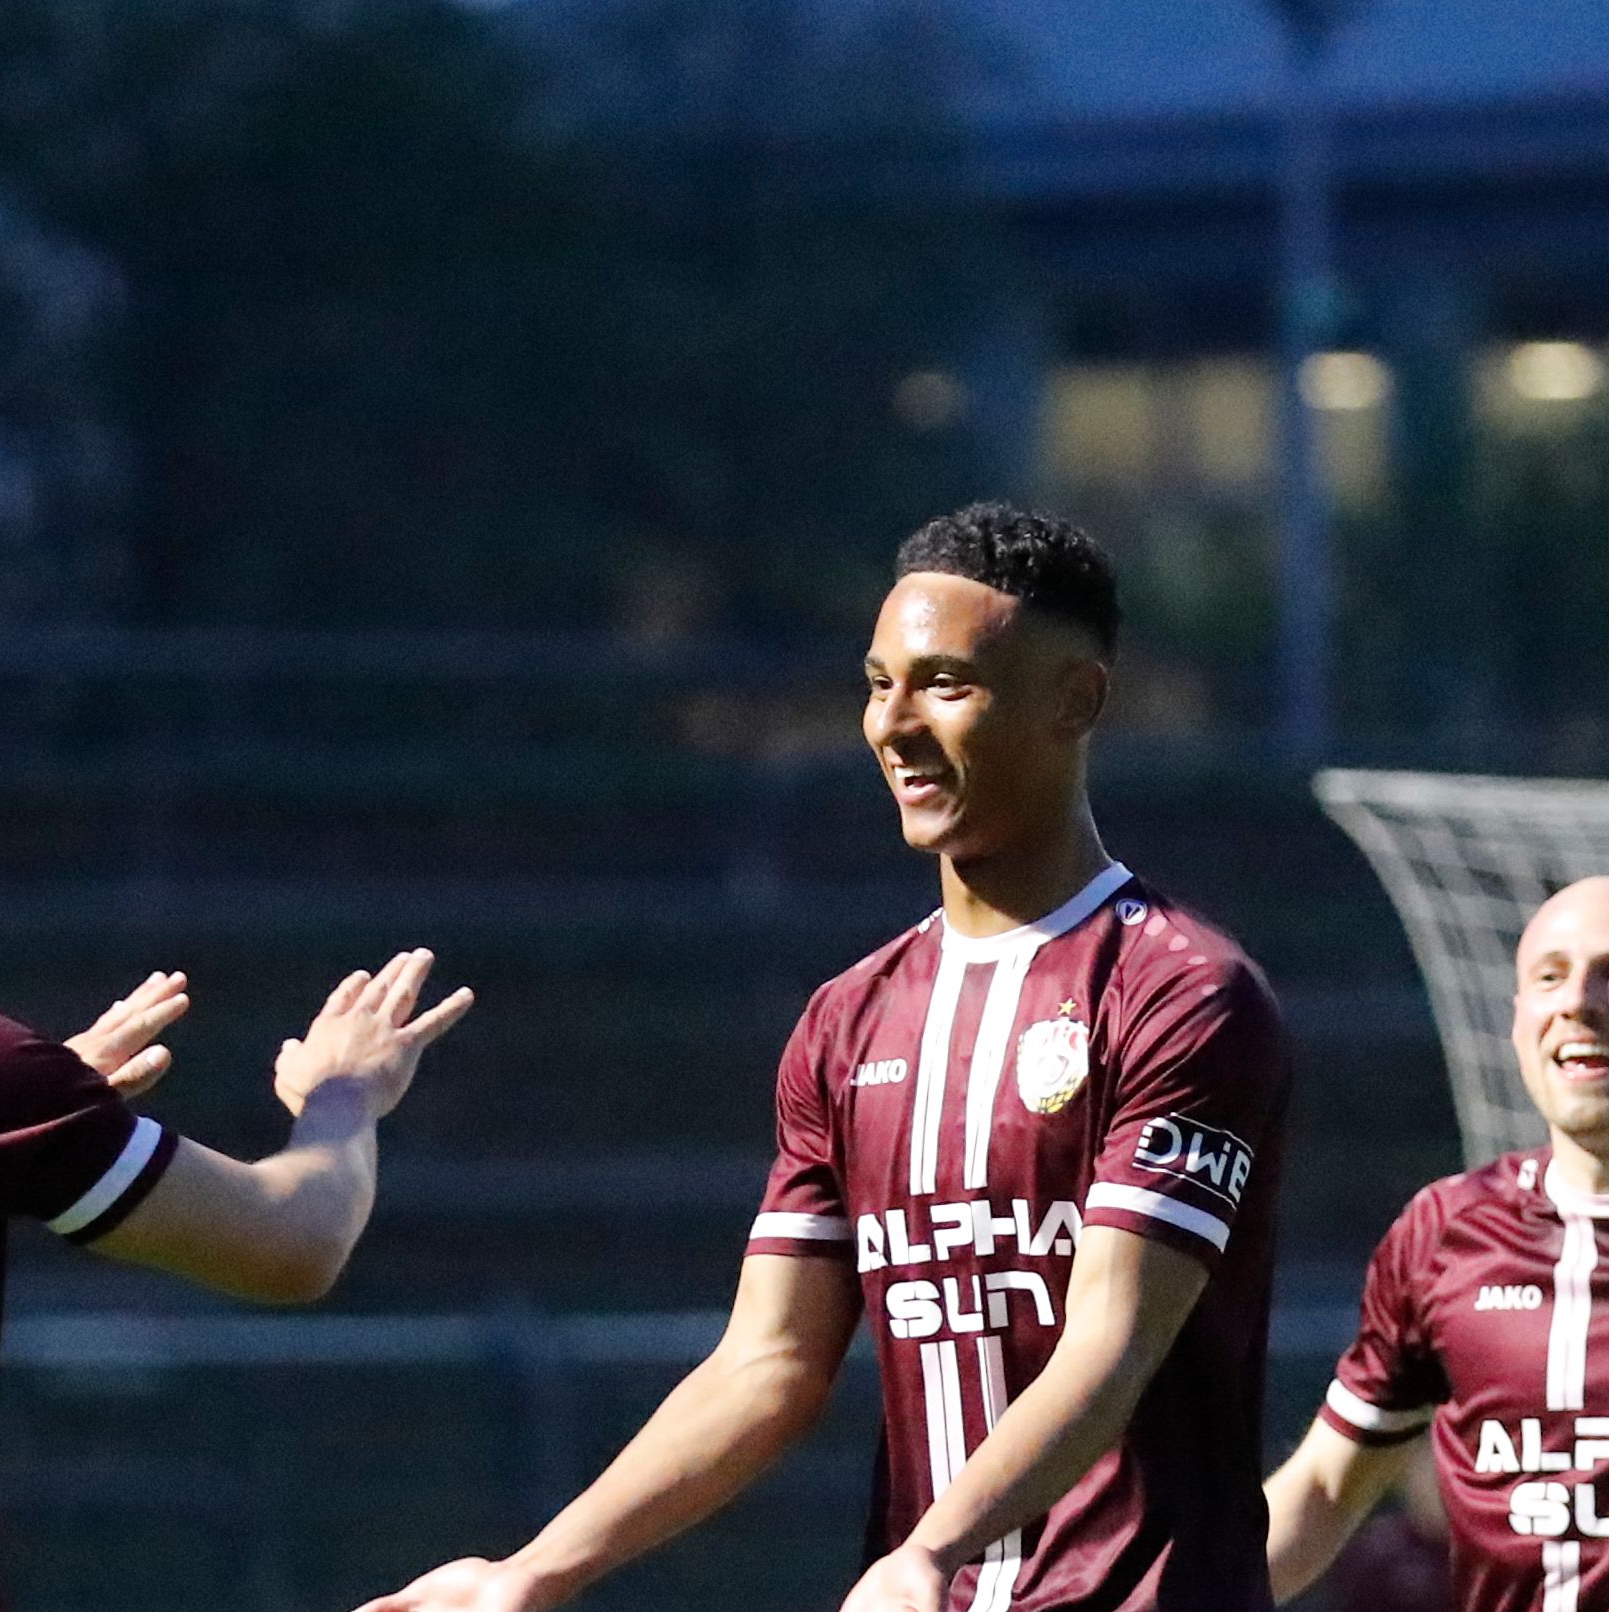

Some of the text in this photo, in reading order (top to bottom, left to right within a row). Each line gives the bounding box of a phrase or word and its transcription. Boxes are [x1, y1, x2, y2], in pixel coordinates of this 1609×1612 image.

[850, 1058, 909, 1088] JAKO
[856, 1198, 1084, 1274] ALPHA
[1474, 1284, 1543, 1311] JAKO
